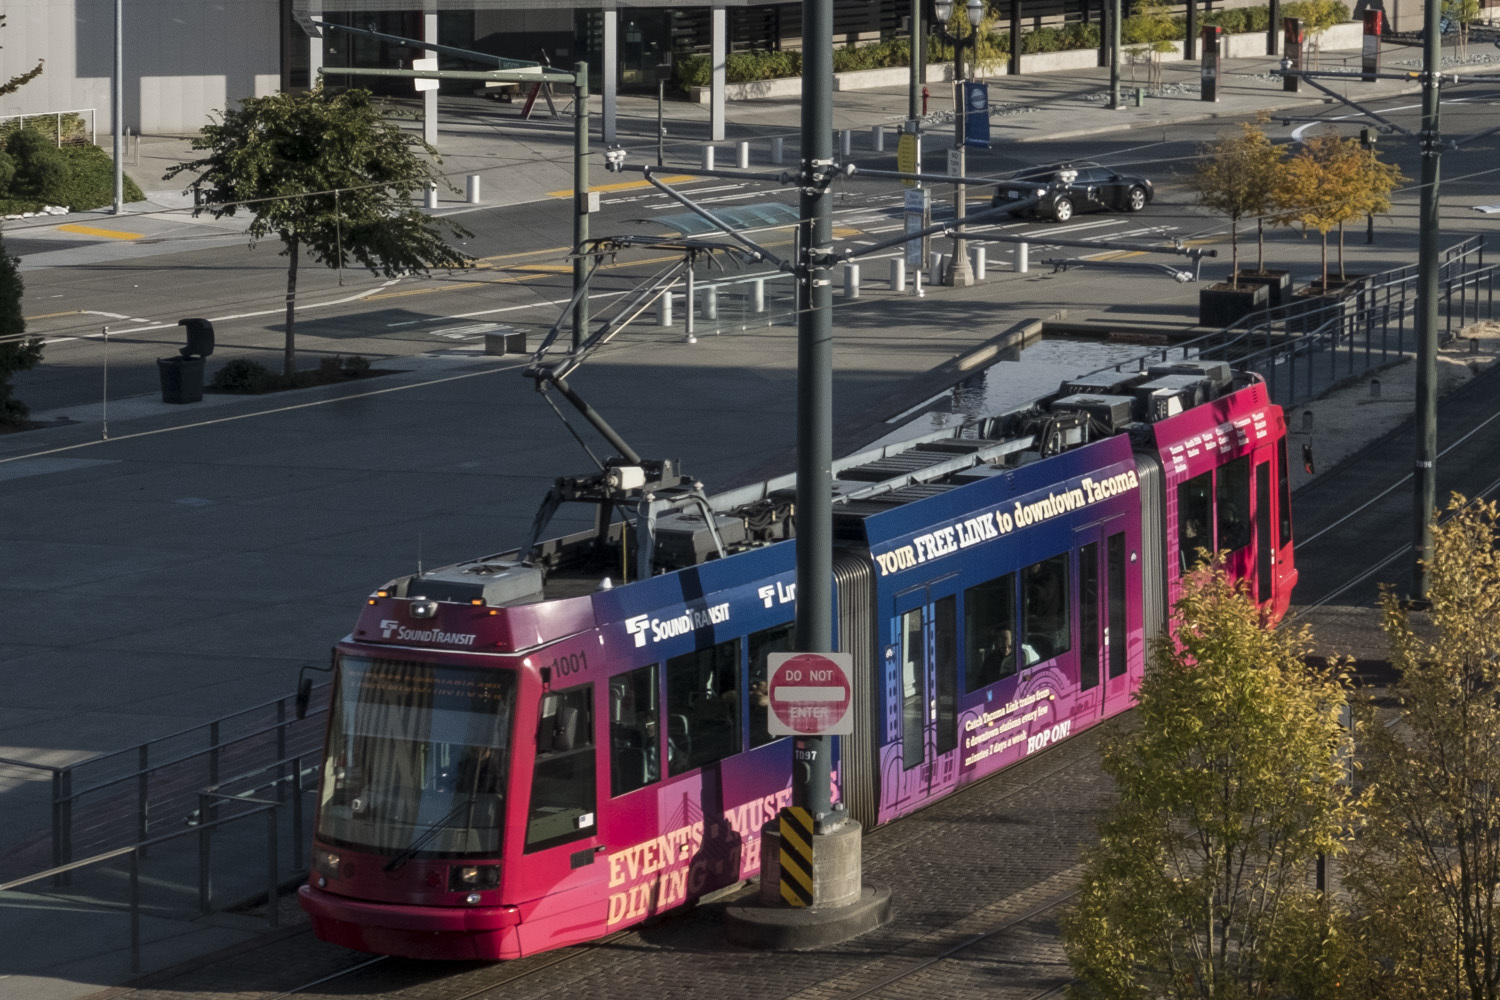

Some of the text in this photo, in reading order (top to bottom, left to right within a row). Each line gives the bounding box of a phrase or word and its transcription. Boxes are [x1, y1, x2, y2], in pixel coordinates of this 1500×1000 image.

[876, 469, 1139, 576] YOUR FREE LINK to downtown Tacoma
[552, 650, 589, 678] 1001
[785, 670, 833, 681] DO NOT
[790, 707, 828, 718] ENTER
[966, 716, 983, 732] Catch
[983, 708, 1005, 725] Tacoma
[1005, 699, 1019, 714] Link
[971, 727, 999, 747] downtown
[999, 716, 1021, 734] stations
[1027, 720, 1071, 755] HOP ON!
[795, 750, 817, 760] T097
[608, 820, 706, 888] EVENTS
[724, 771, 838, 843] MUSES
[607, 857, 707, 926] DINING
